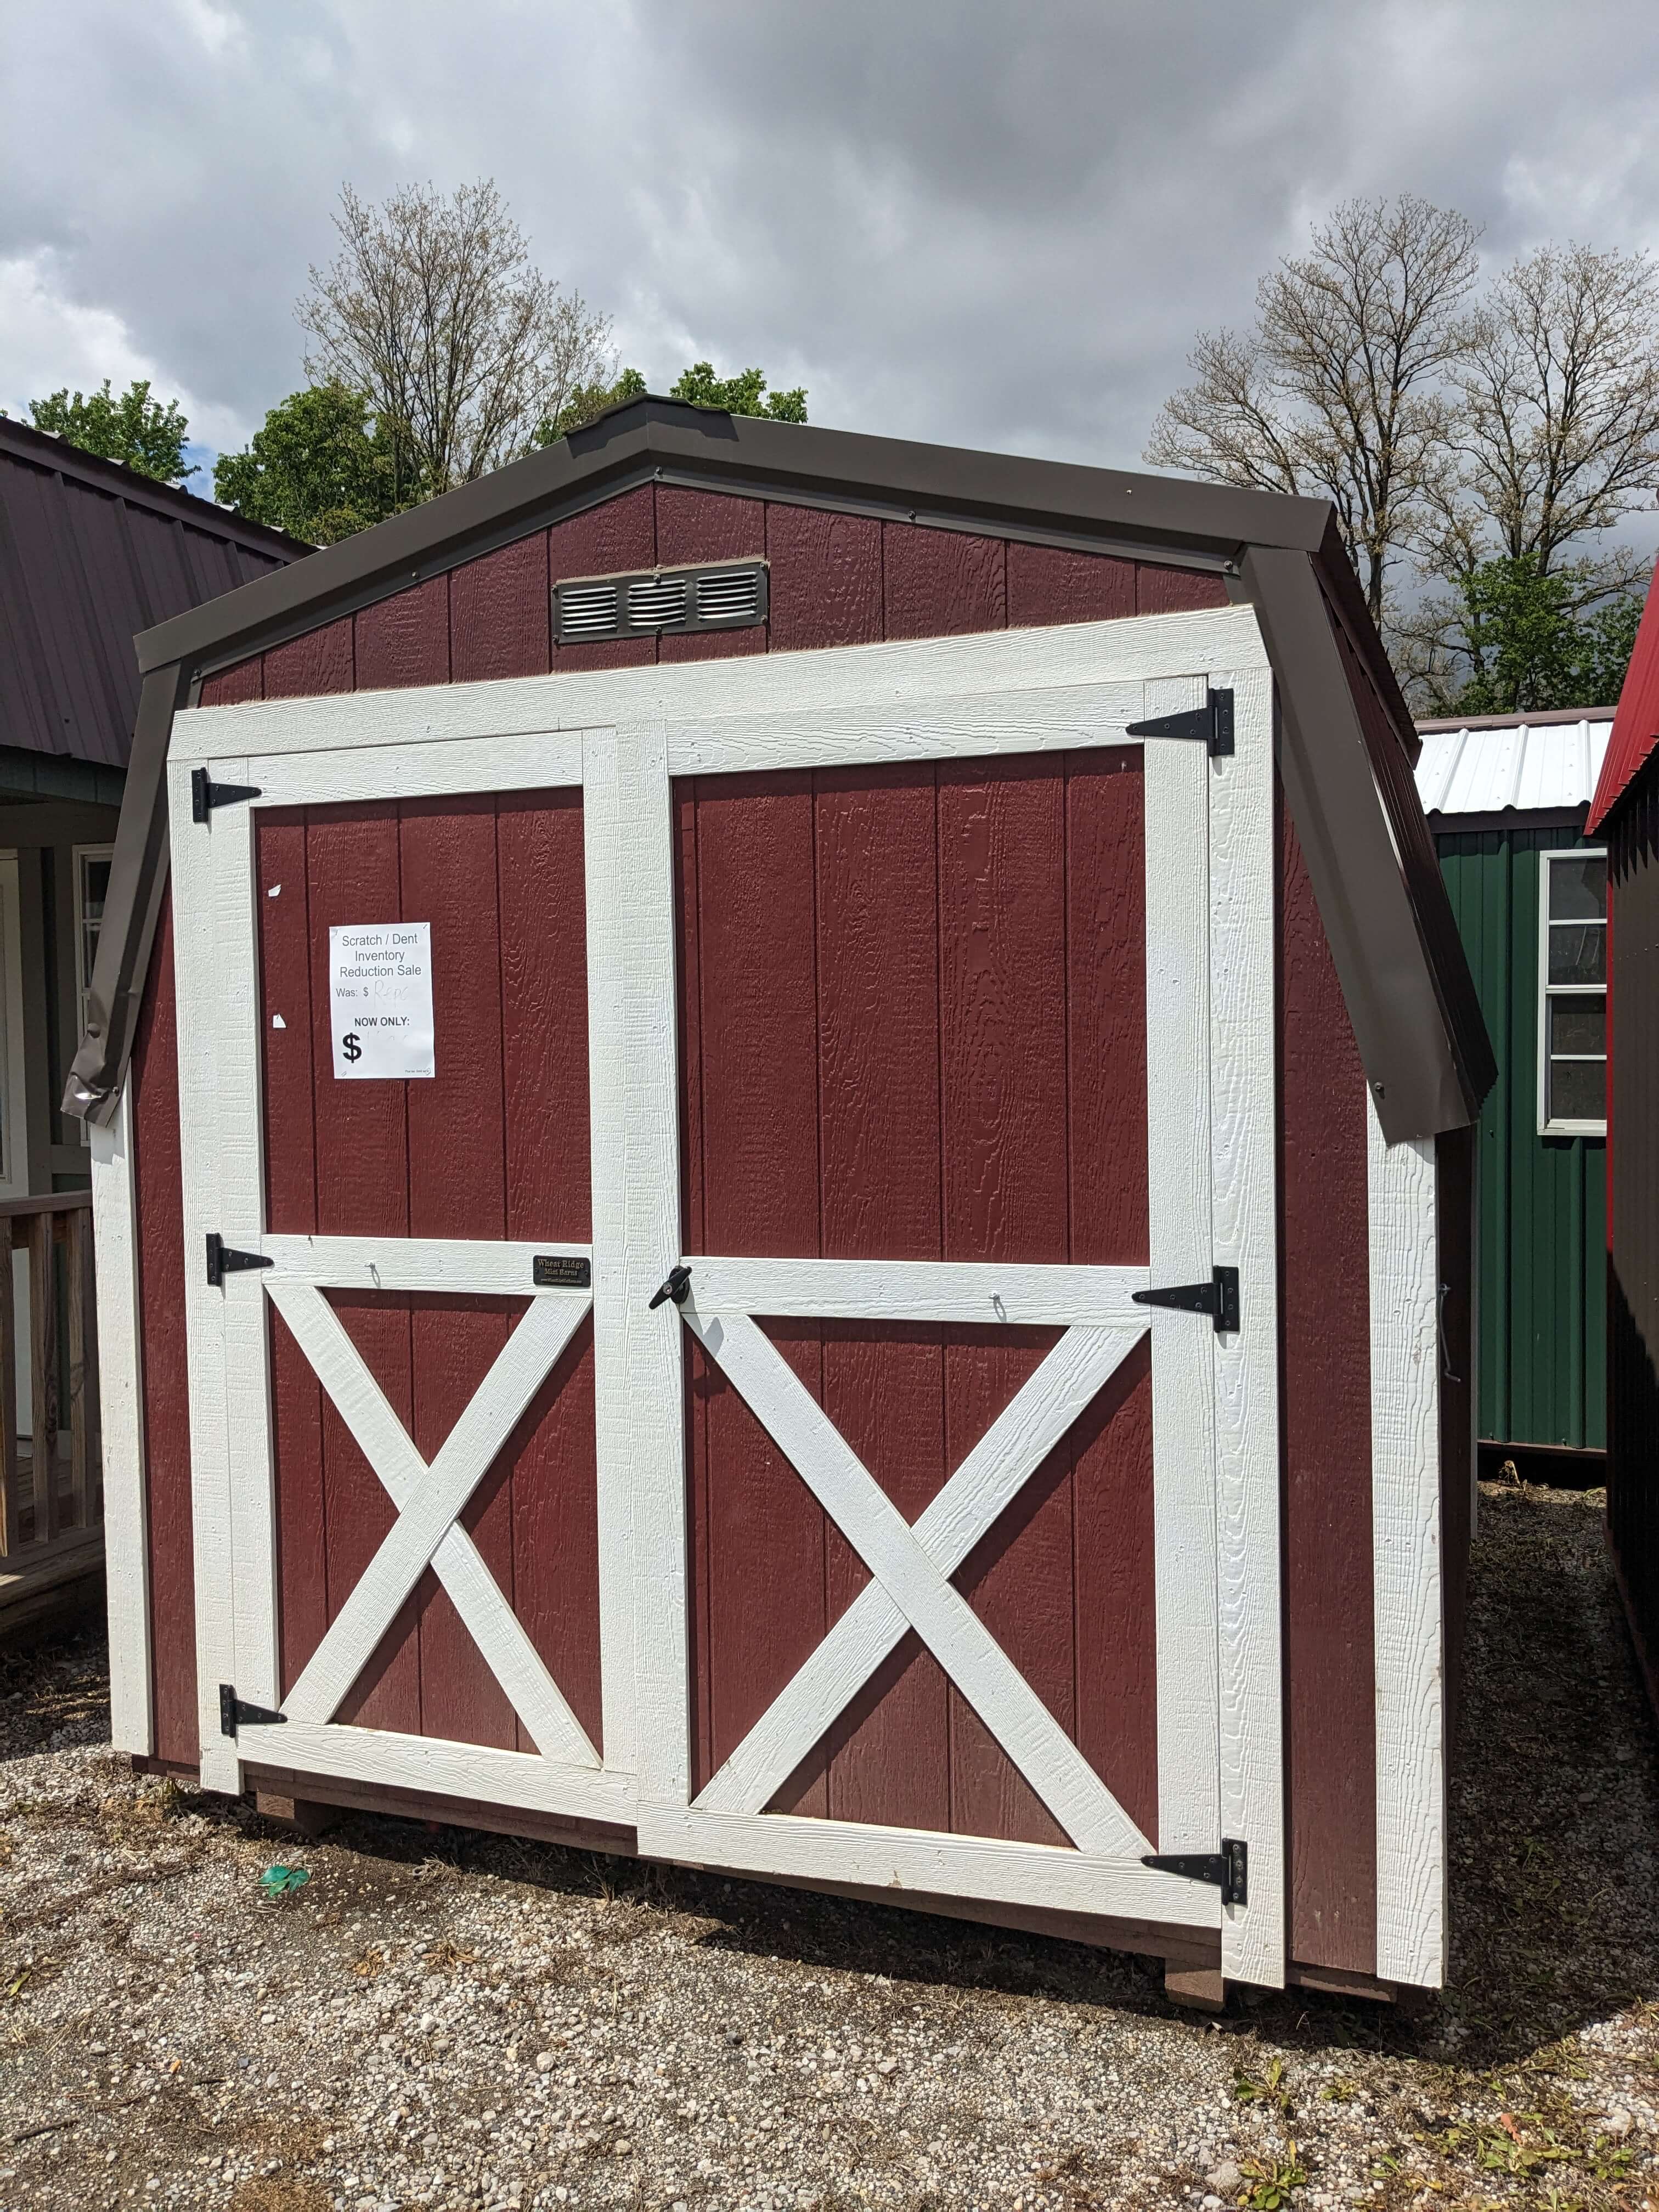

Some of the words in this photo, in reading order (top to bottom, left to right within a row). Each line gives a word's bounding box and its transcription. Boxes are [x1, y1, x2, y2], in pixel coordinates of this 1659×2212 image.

[342, 935, 382, 946] Scratch
[386, 934, 389, 945] /
[393, 933, 418, 945] Dent
[356, 950, 405, 962] Inventory
[340, 966, 393, 977] Reduction
[397, 964, 421, 975] Sale
[336, 988, 358, 997] Was:
[363, 987, 369, 997] $
[354, 1017, 377, 1026] NOW
[380, 1017, 410, 1026] ONLY:
[342, 1032, 362, 1063] $
[538, 1259, 561, 1267] Wheat
[562, 1260, 584, 1269] Ridge
